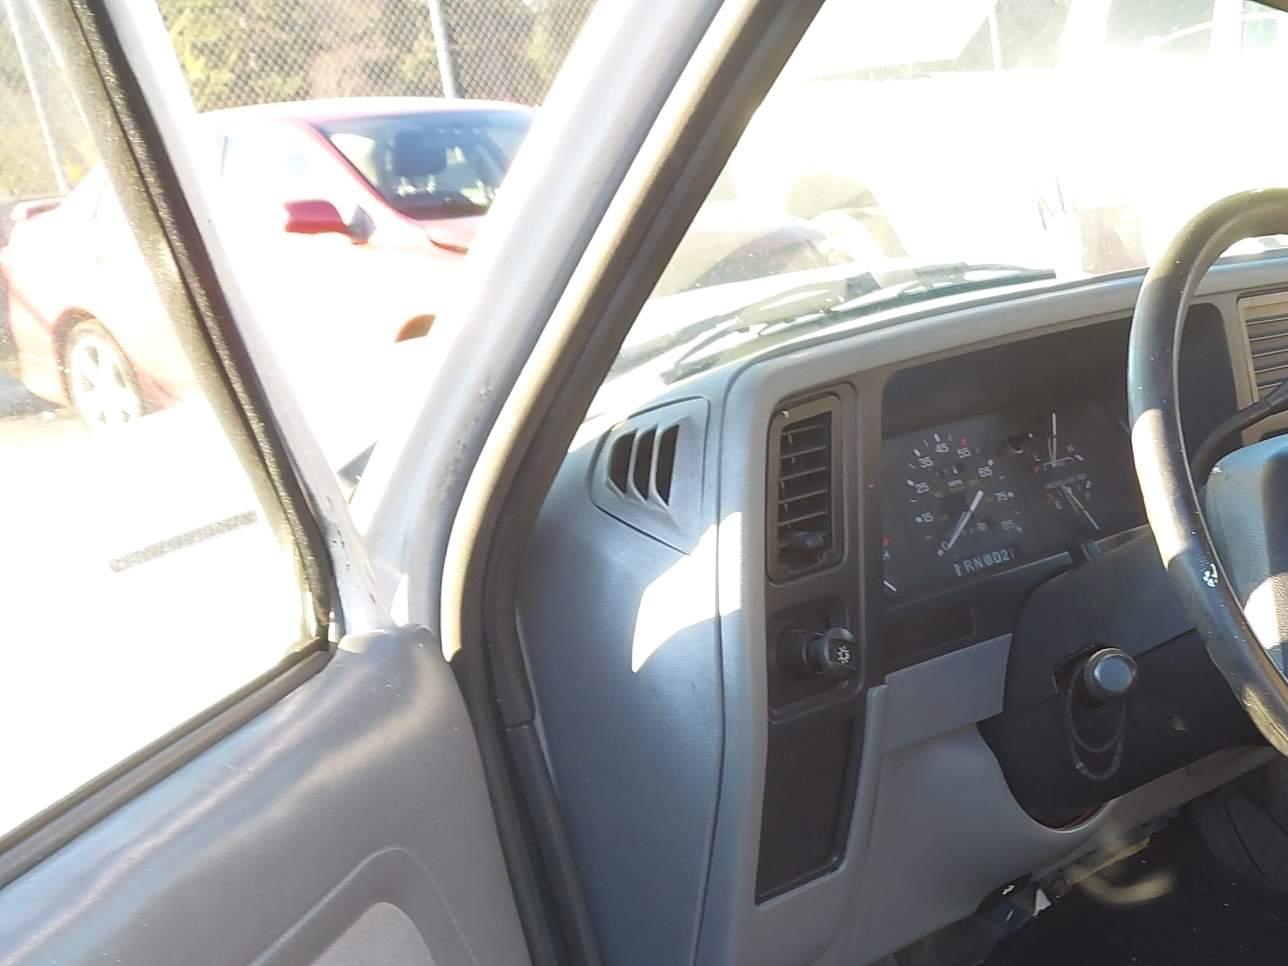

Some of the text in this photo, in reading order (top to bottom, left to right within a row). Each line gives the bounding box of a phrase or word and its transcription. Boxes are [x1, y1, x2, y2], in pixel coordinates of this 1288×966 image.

[935, 442, 949, 454] 45
[957, 447, 971, 459] 55
[919, 456, 934, 469] 35
[978, 466, 993, 478] 65
[914, 482, 930, 494] 25
[994, 491, 1008, 503] 75
[921, 512, 934, 523] 15
